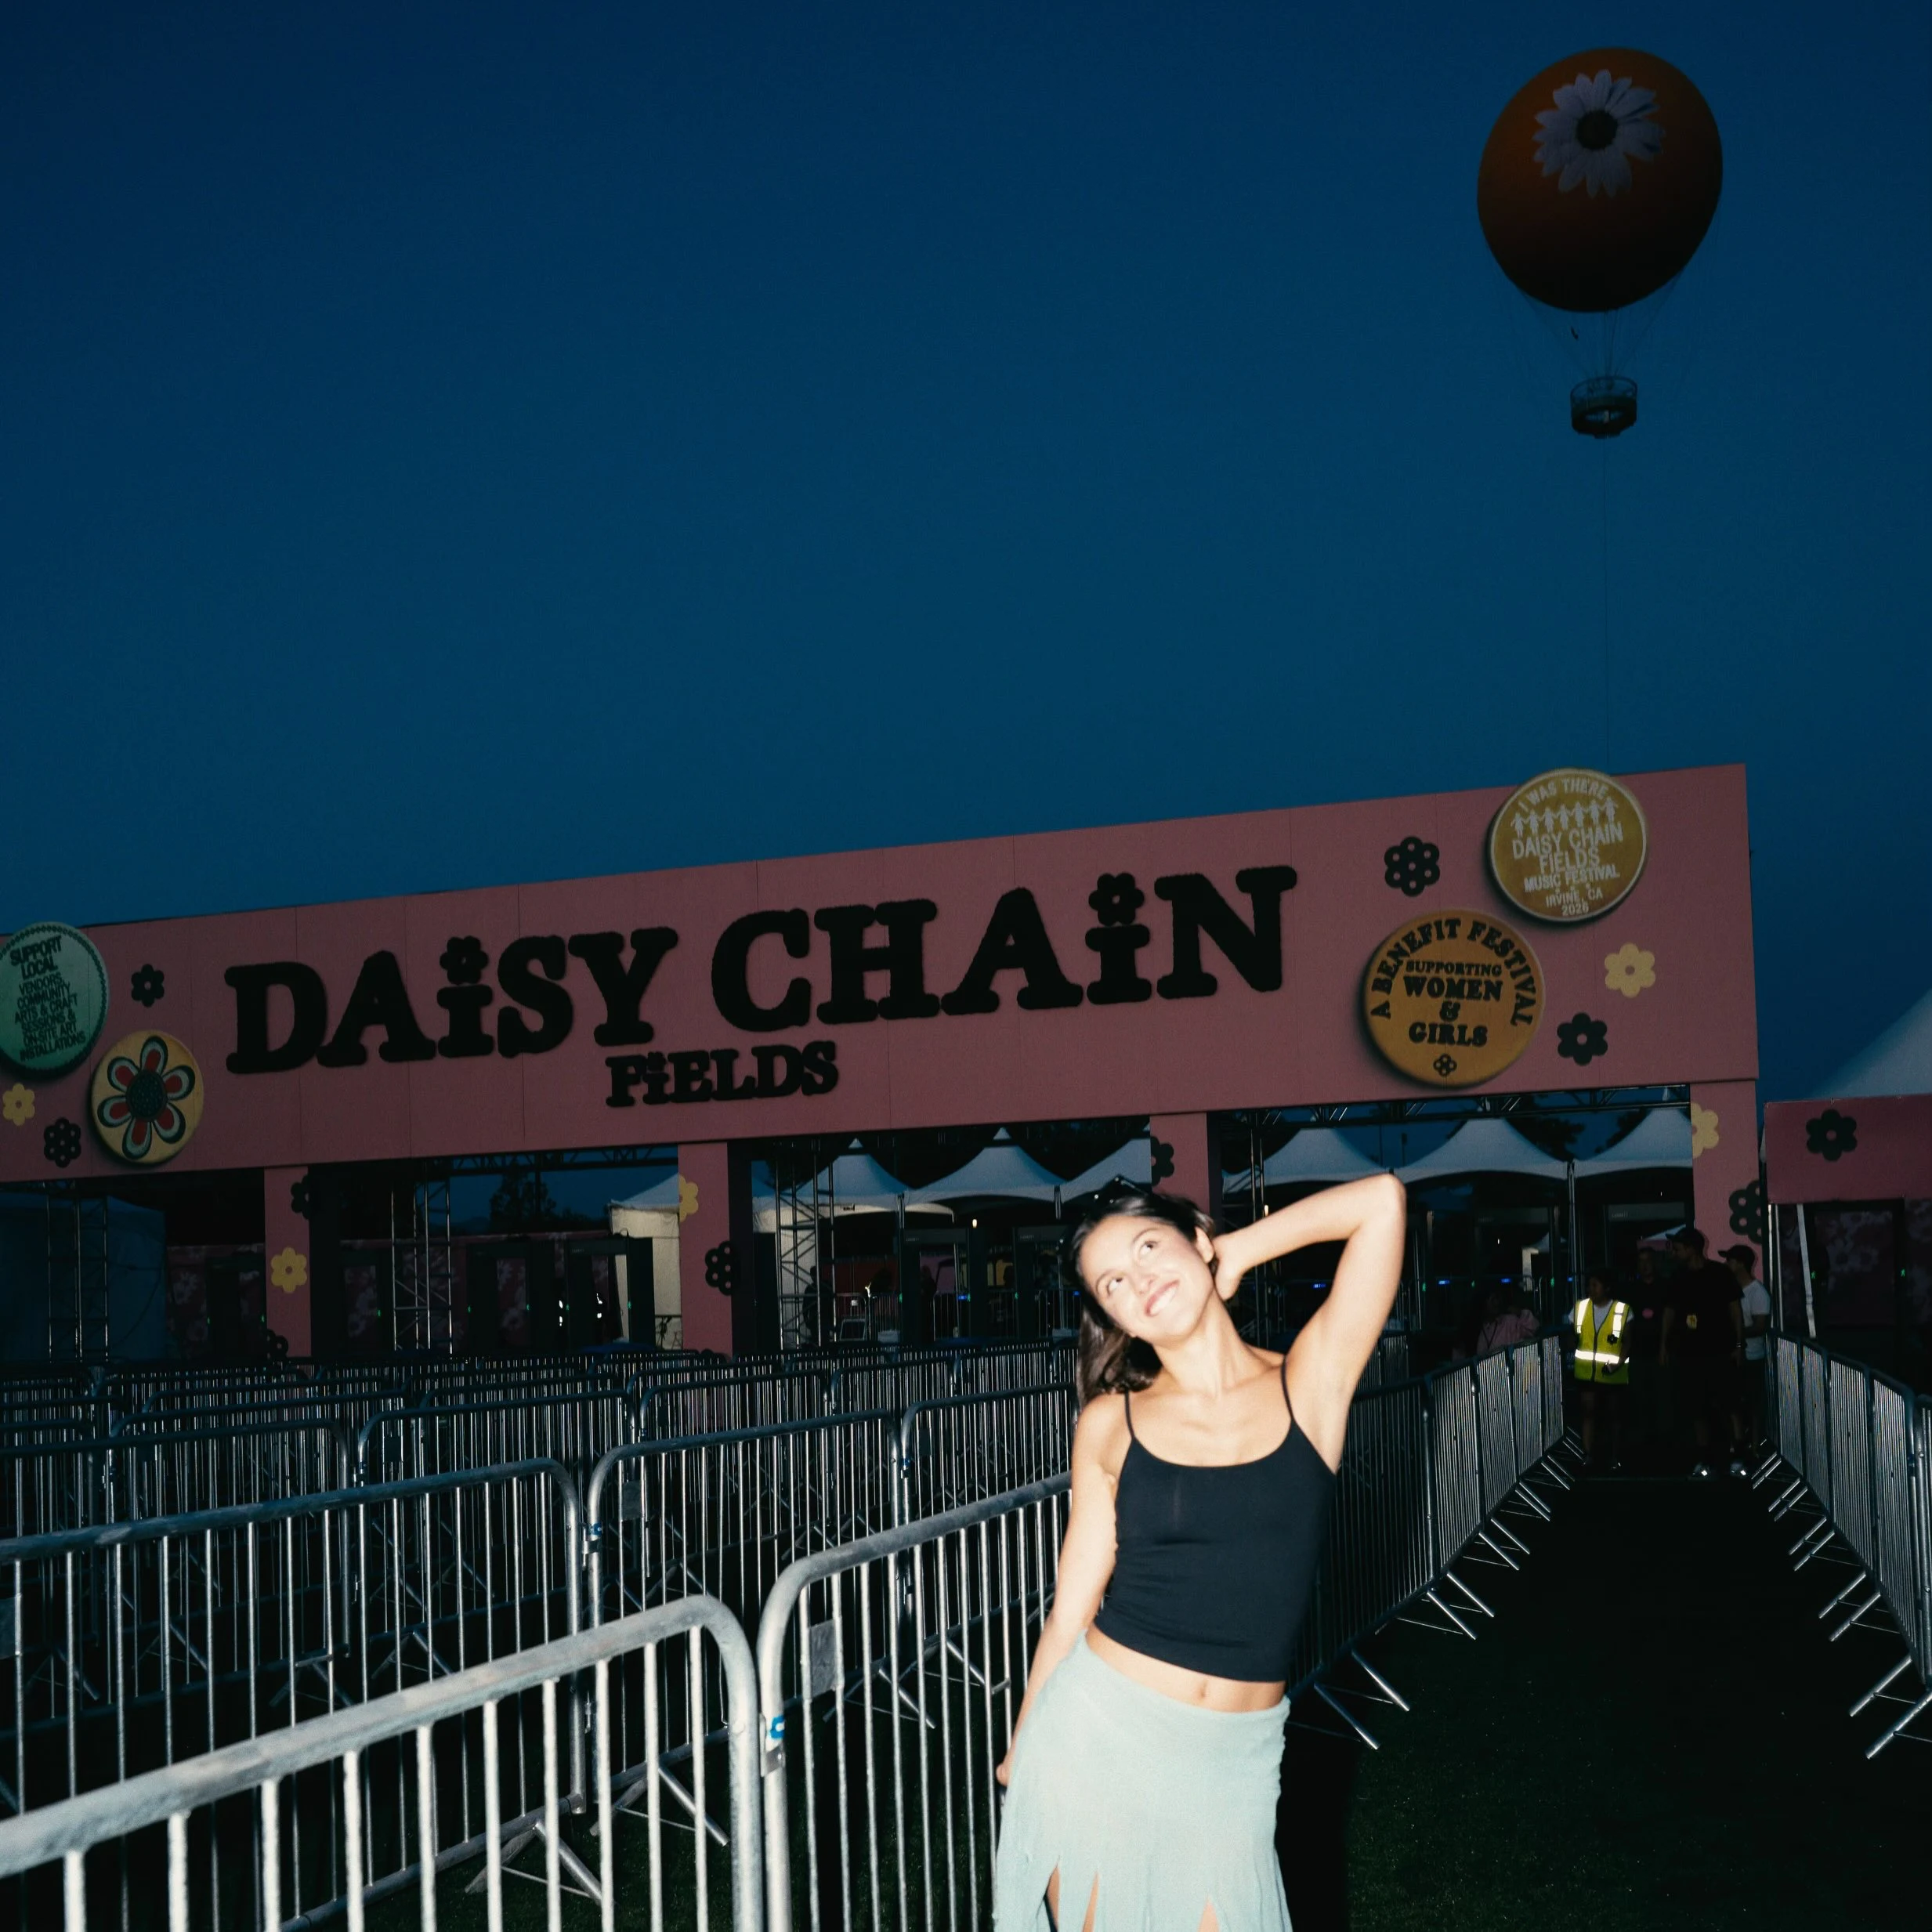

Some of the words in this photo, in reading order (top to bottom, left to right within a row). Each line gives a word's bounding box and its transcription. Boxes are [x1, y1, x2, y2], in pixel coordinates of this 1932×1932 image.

[1526, 781, 1557, 805] WAS
[1561, 778, 1608, 800] THERE
[1512, 832, 1562, 859] DAISY
[1569, 821, 1623, 849] CHAIN
[1539, 845, 1600, 875] FIELDS
[1524, 874, 1561, 892] MUSIC
[1565, 864, 1620, 885] FESTIVAL
[1588, 887, 1603, 900] CA
[1561, 903, 1589, 916] 2026
[10, 935, 61, 966] SUPPORT
[1372, 918, 1461, 995] BENEFIT
[21, 955, 58, 979] LOCAL
[1406, 960, 1503, 977] SUPPORTING
[1467, 920, 1536, 1026] FESTIVAL
[1403, 975, 1503, 1002] WOMEN
[15, 1007, 38, 1025] ARTS
[49, 993, 77, 1012] CRAFT
[1371, 1000, 1391, 1019] A
[1439, 1000, 1460, 1022] &
[60, 1022, 77, 1035] ART
[1409, 1022, 1488, 1047] GIRLS
